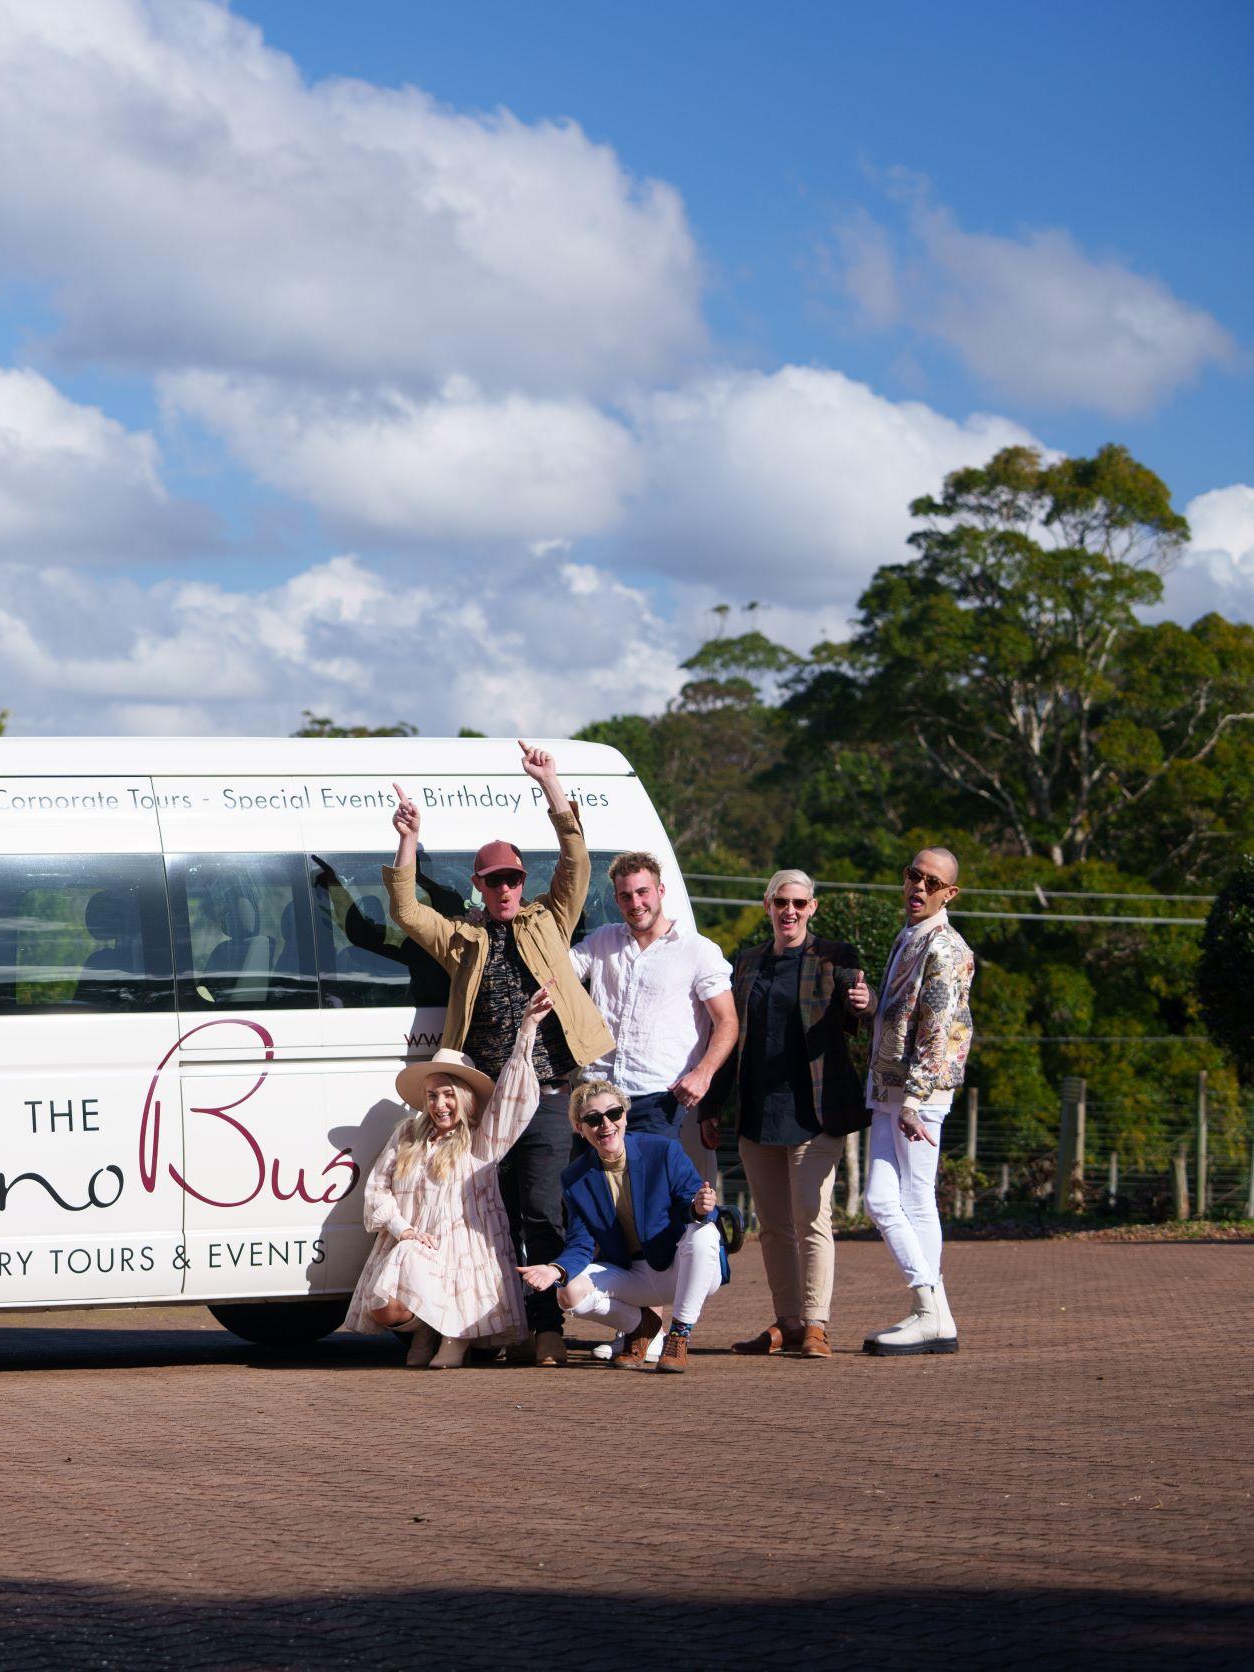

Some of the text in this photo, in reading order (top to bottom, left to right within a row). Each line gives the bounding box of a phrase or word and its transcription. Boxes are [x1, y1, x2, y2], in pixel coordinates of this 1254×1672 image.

[126, 788, 193, 810] Tours
[222, 785, 311, 811] Special
[320, 788, 396, 808] Events
[422, 785, 522, 814] Birthday
[530, 786, 609, 807] Pties
[24, 1098, 100, 1134] THE
[138, 1018, 362, 1208] Bus
[49, 1246, 156, 1276] TOURS
[172, 1245, 192, 1271] &
[208, 1239, 327, 1269] EVENTS
